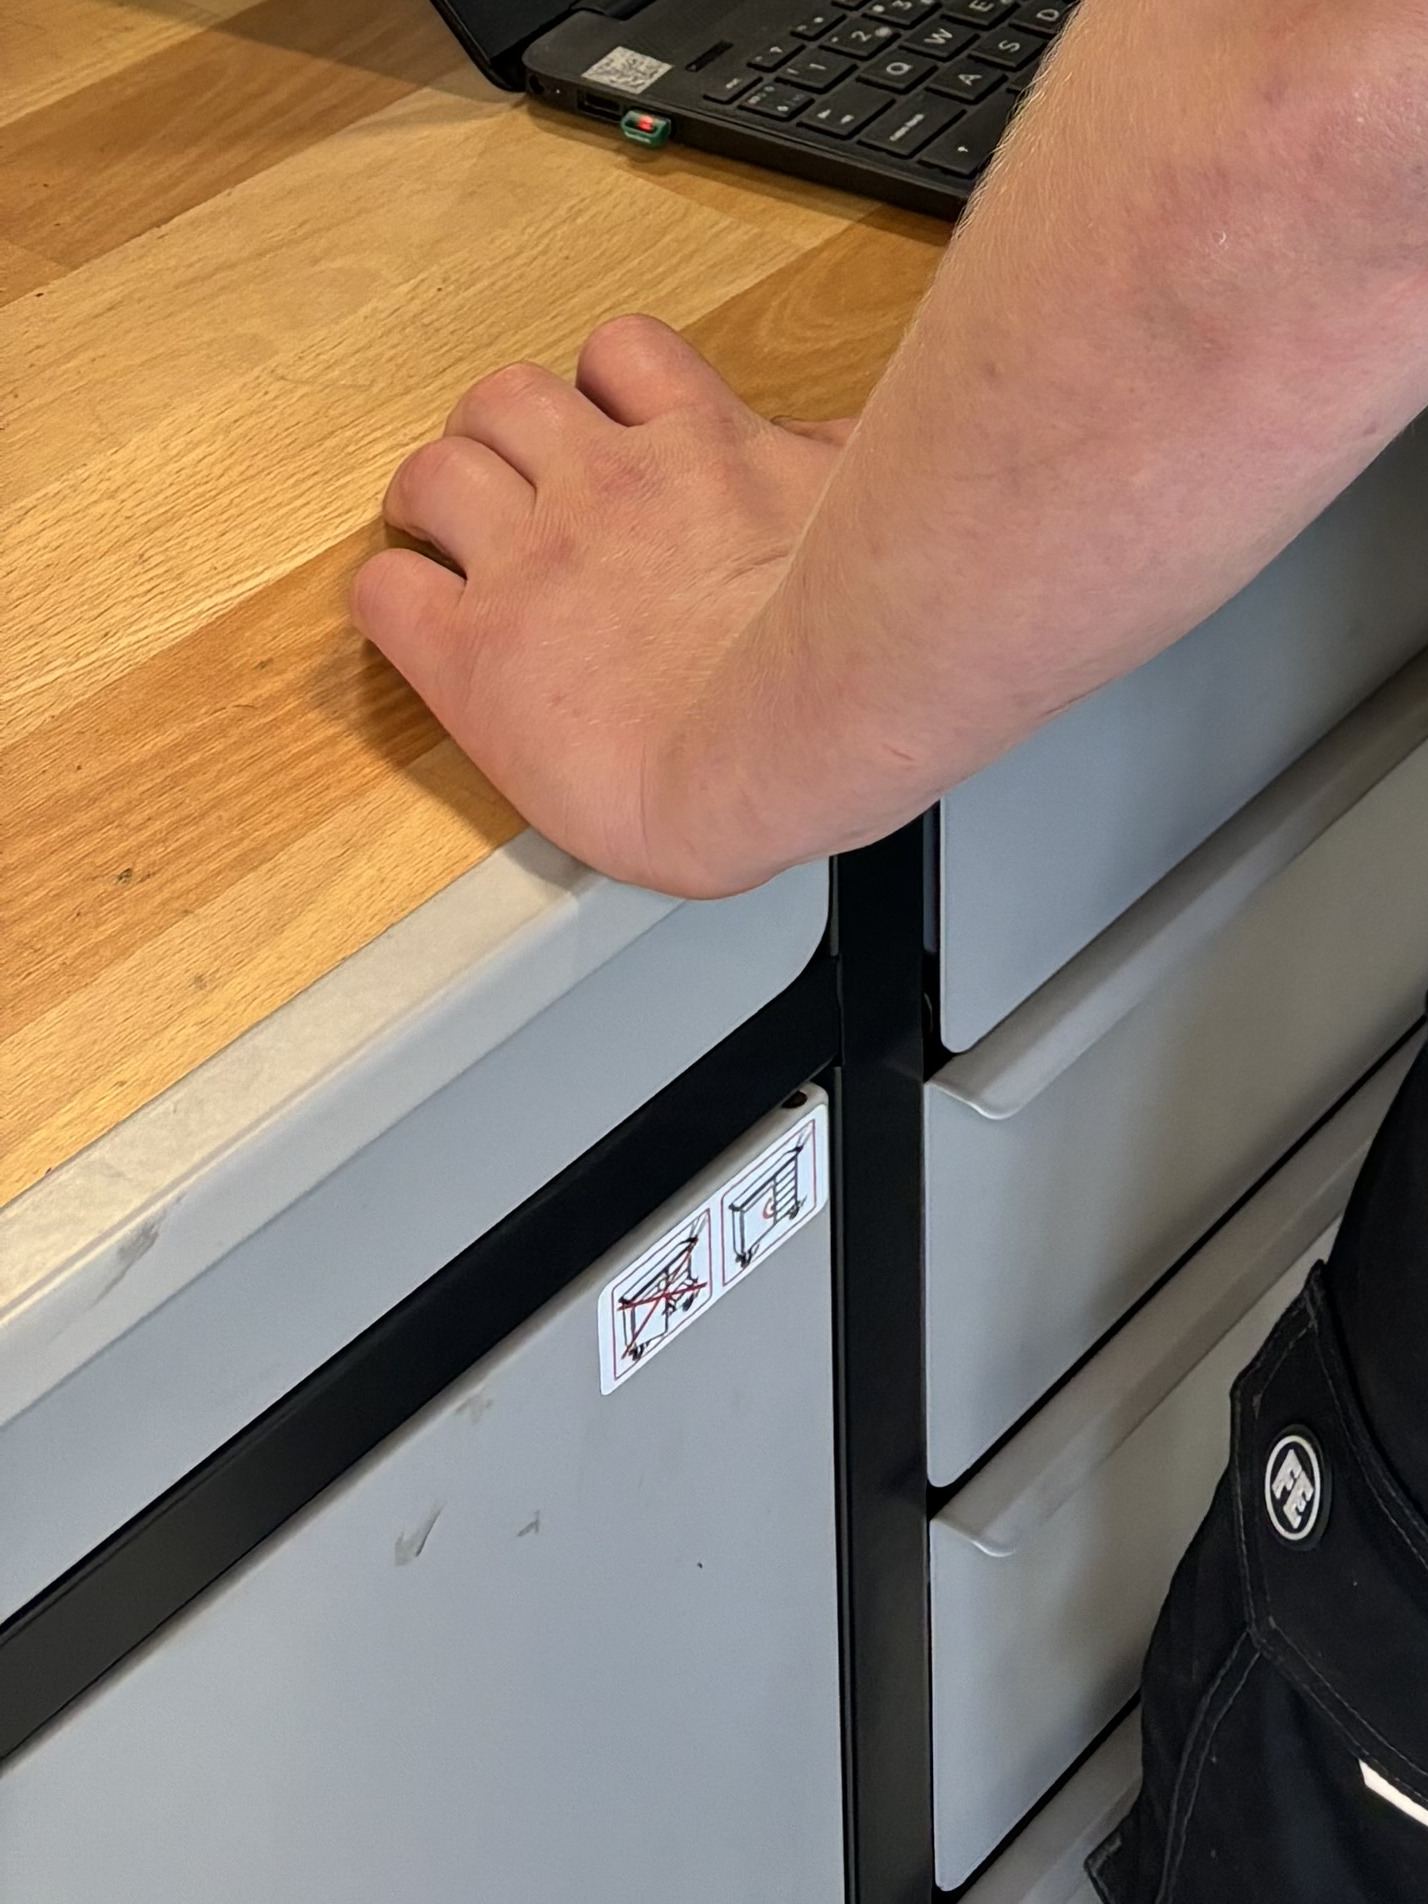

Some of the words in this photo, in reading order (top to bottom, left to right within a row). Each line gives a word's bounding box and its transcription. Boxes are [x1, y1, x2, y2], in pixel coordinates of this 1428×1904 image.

[969, 0, 994, 12] E
[1036, 8, 1060, 21] D
[851, 30, 872, 41] 2
[924, 28, 953, 44] W
[998, 40, 1020, 52] S
[886, 62, 912, 75] Q
[958, 74, 982, 86] A
